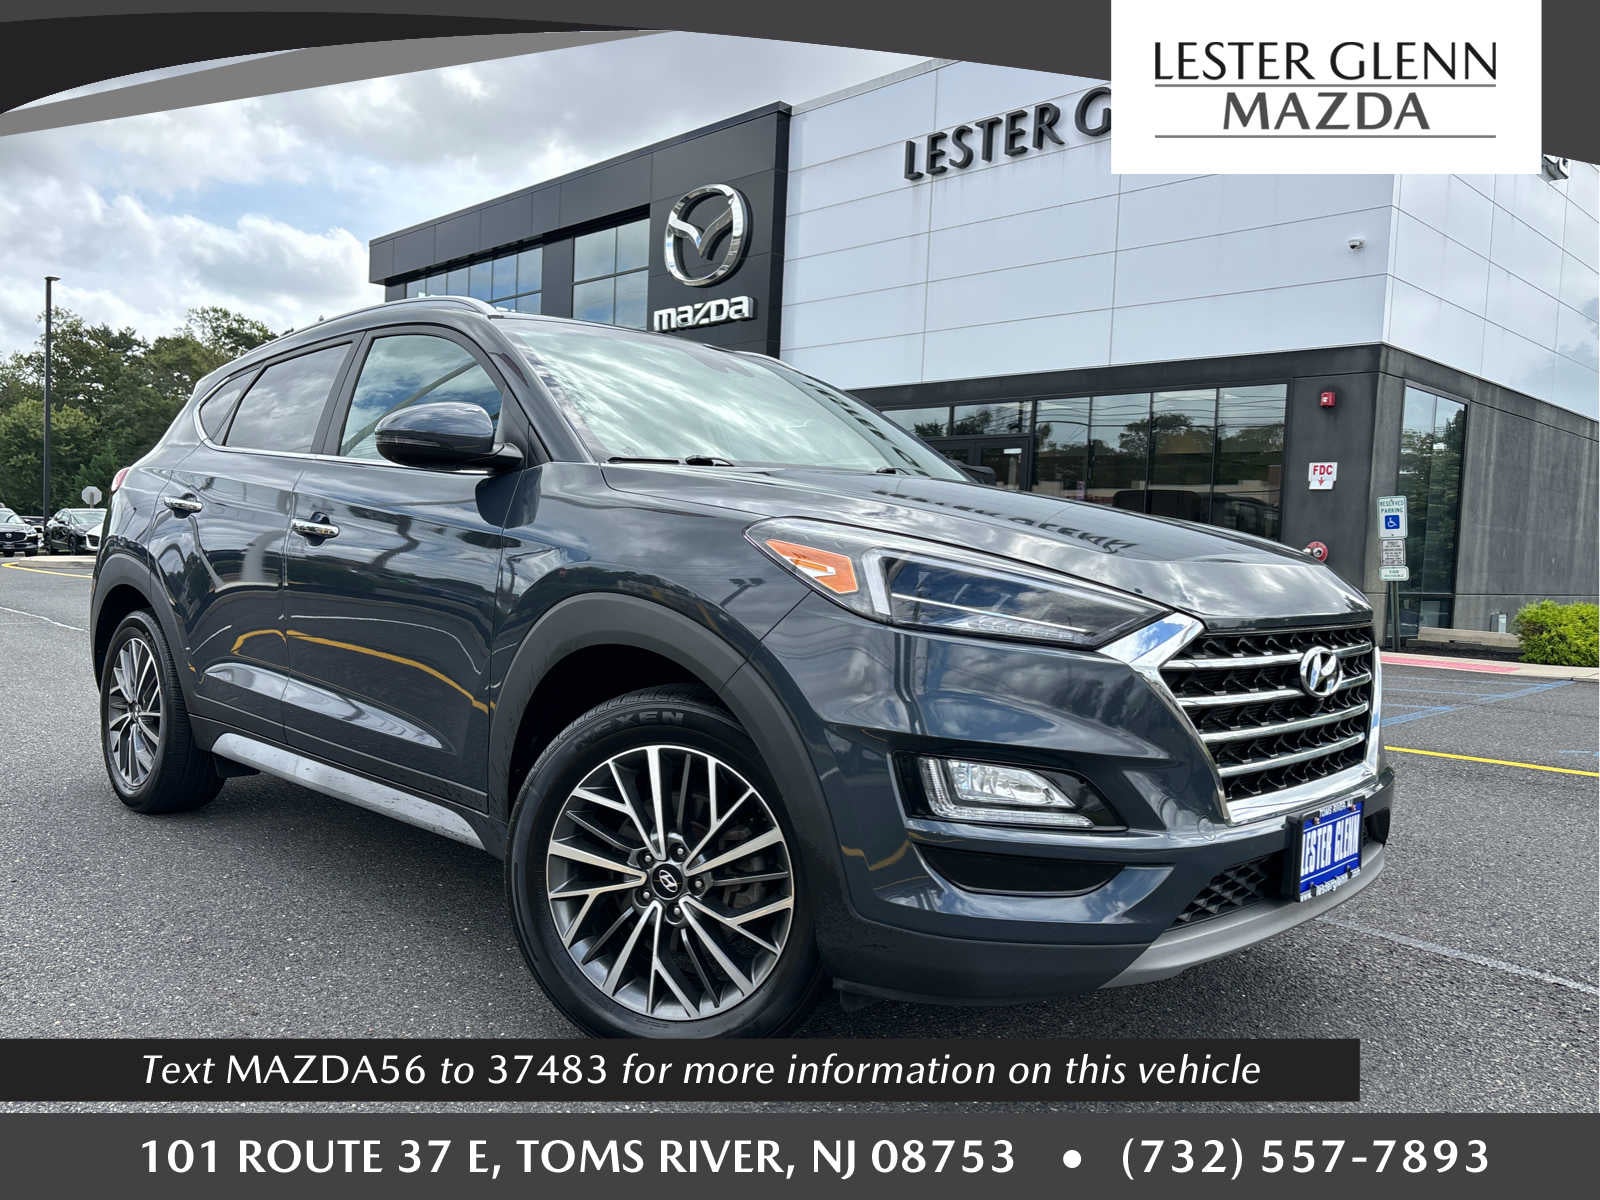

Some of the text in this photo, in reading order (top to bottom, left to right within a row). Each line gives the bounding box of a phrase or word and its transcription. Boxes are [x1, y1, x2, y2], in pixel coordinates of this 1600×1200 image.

[904, 103, 1065, 180] LESTER
[1313, 464, 1333, 476] FDC
[1300, 813, 1360, 877] LESTER GLENN
